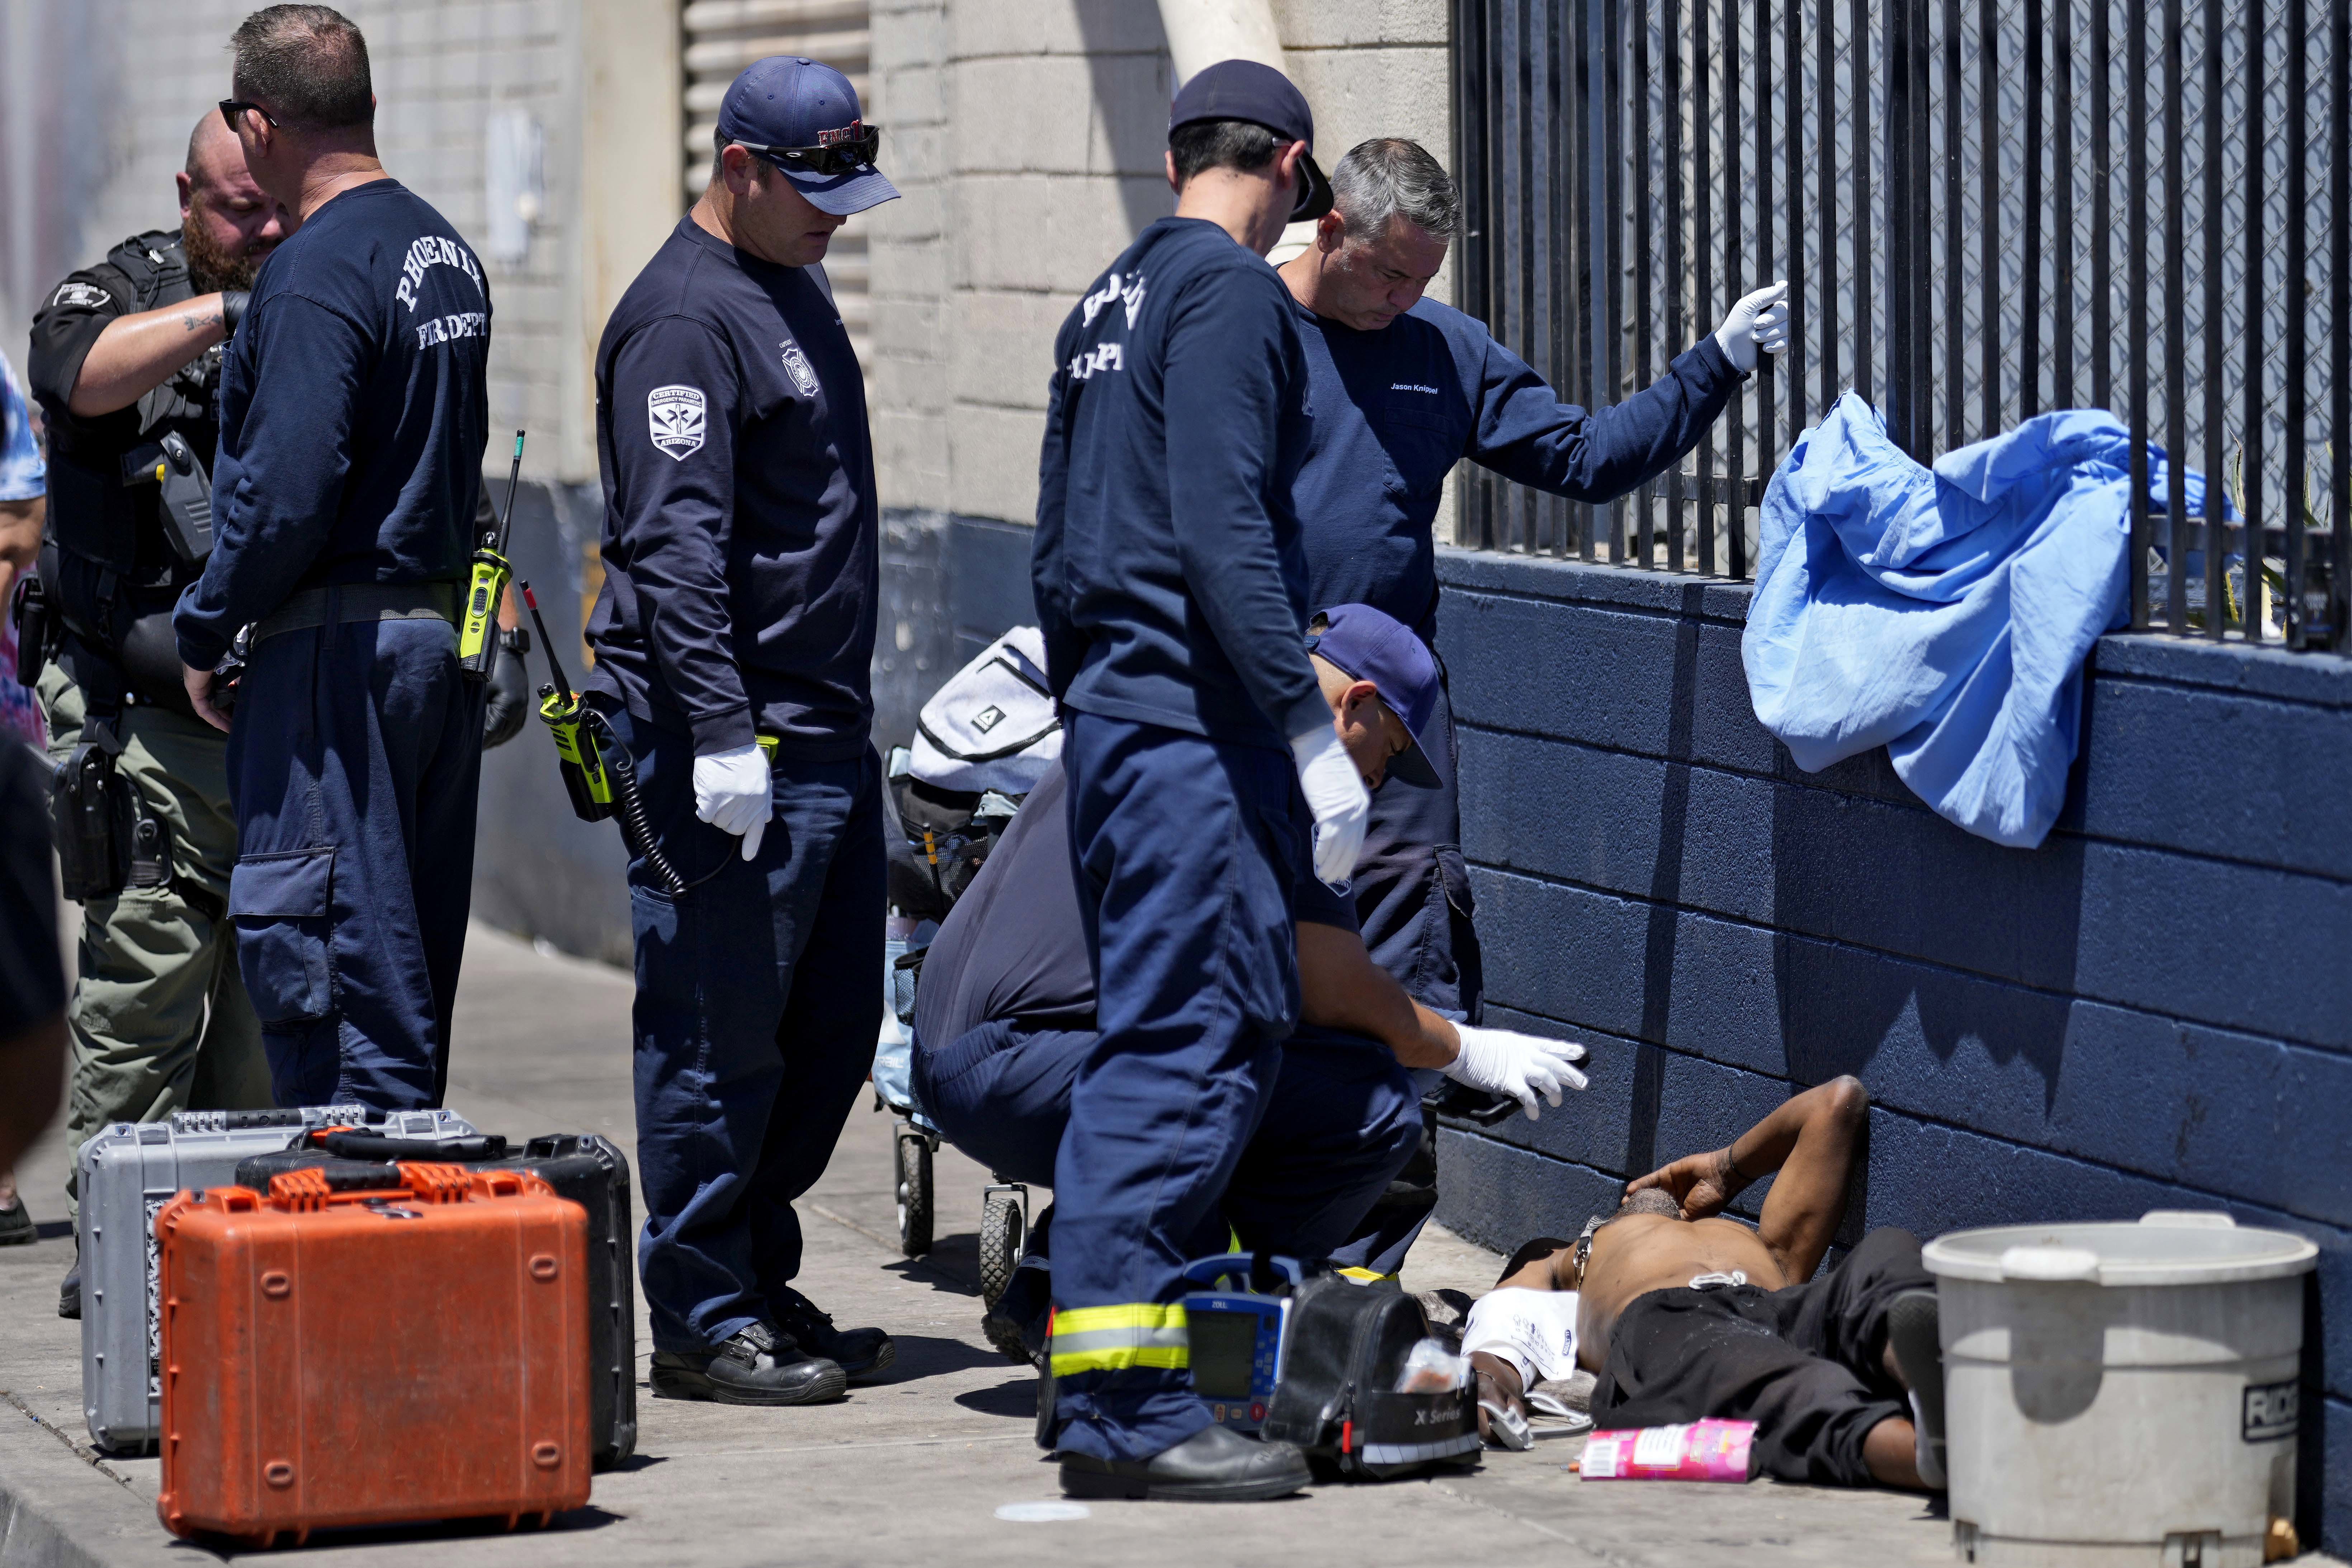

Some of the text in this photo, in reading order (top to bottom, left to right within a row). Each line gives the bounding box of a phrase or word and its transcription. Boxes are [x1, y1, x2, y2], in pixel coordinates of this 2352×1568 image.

[446, 312, 486, 339] DEPT
[779, 339, 792, 349] CAPTAIN
[1413, 384, 1438, 394] Knippel
[652, 390, 700, 400] CERTIFIED
[651, 397, 702, 406] EMERGENCY PARAMEDIC
[660, 438, 696, 447] ARIZONA
[1212, 1300, 1227, 1309] ZOLL
[1414, 1406, 1460, 1426] X Series
